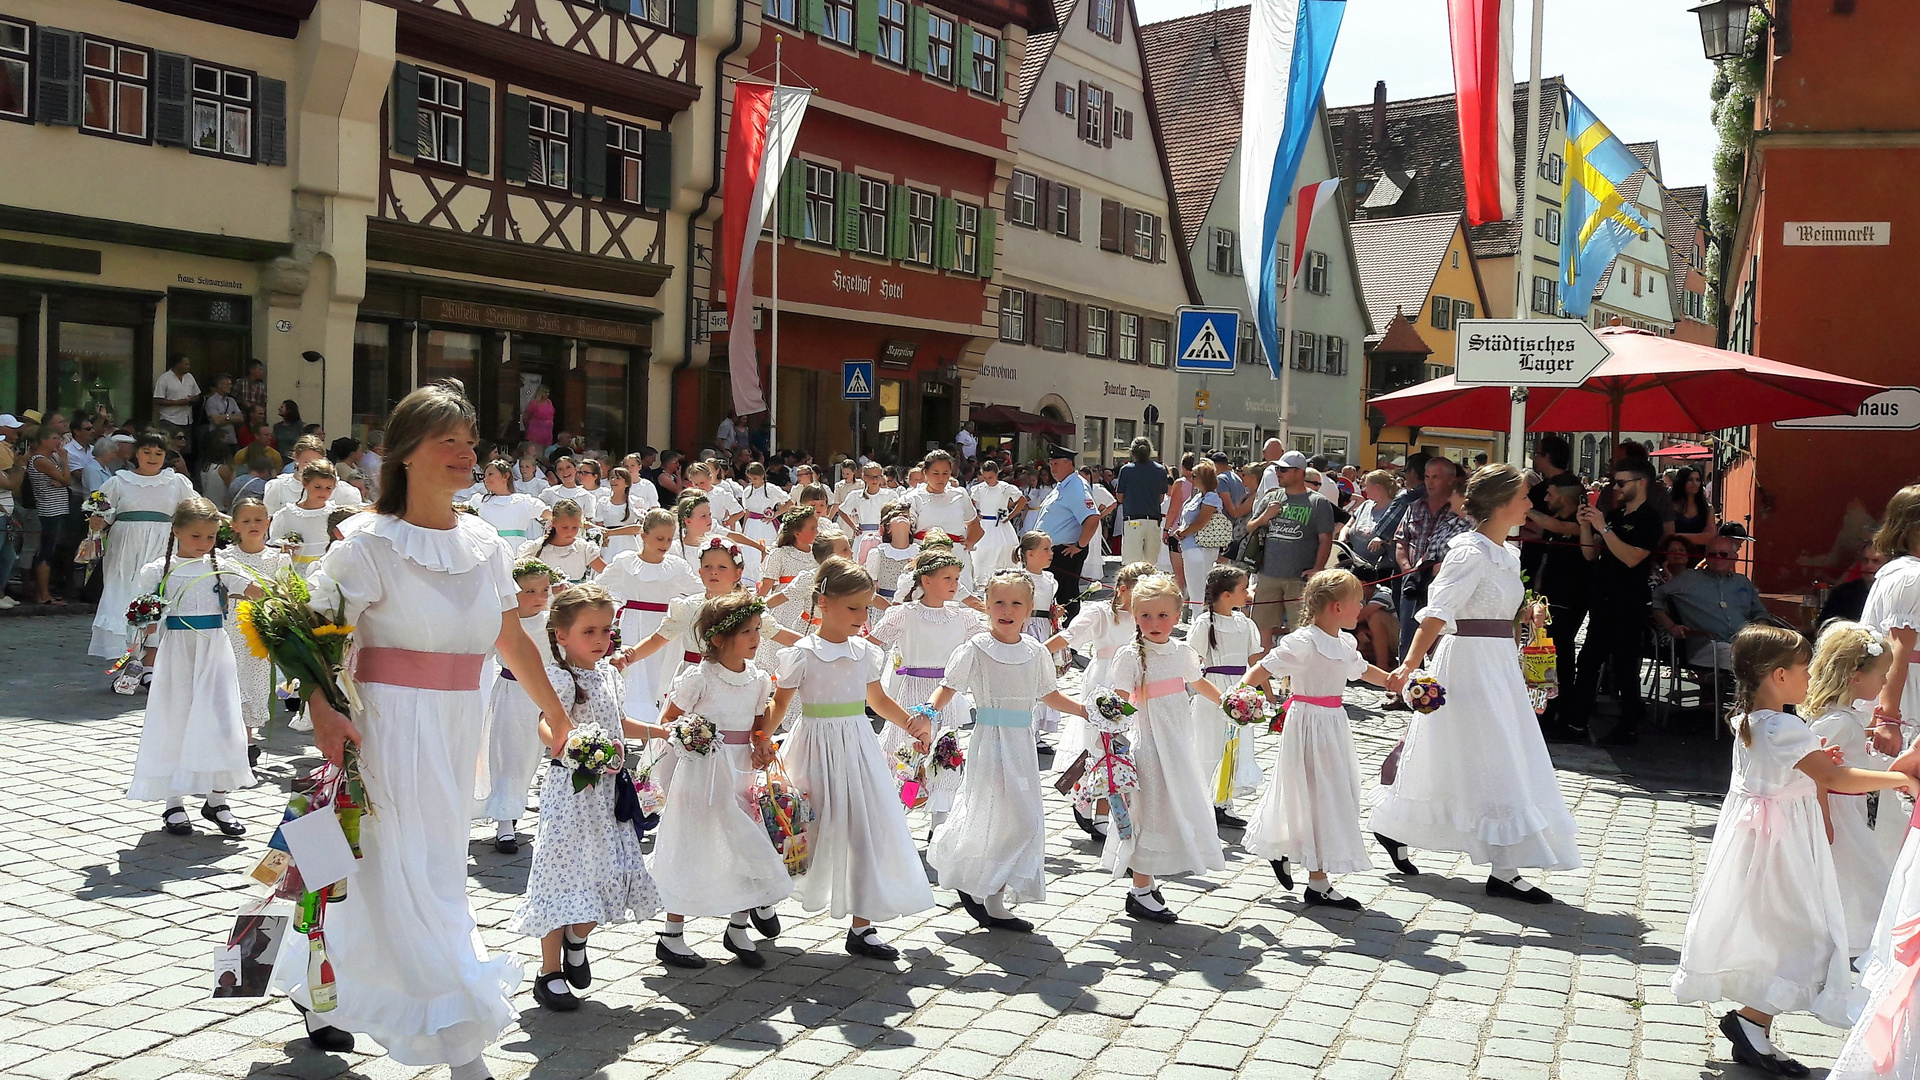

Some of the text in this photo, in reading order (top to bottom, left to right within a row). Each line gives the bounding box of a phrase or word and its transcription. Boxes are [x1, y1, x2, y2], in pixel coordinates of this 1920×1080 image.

[1796, 225, 1875, 242] Weinmarkt
[832, 269, 905, 300] Hezelhof Hotel
[1468, 334, 1576, 356] Städtisches
[1519, 353, 1575, 375] Lager
